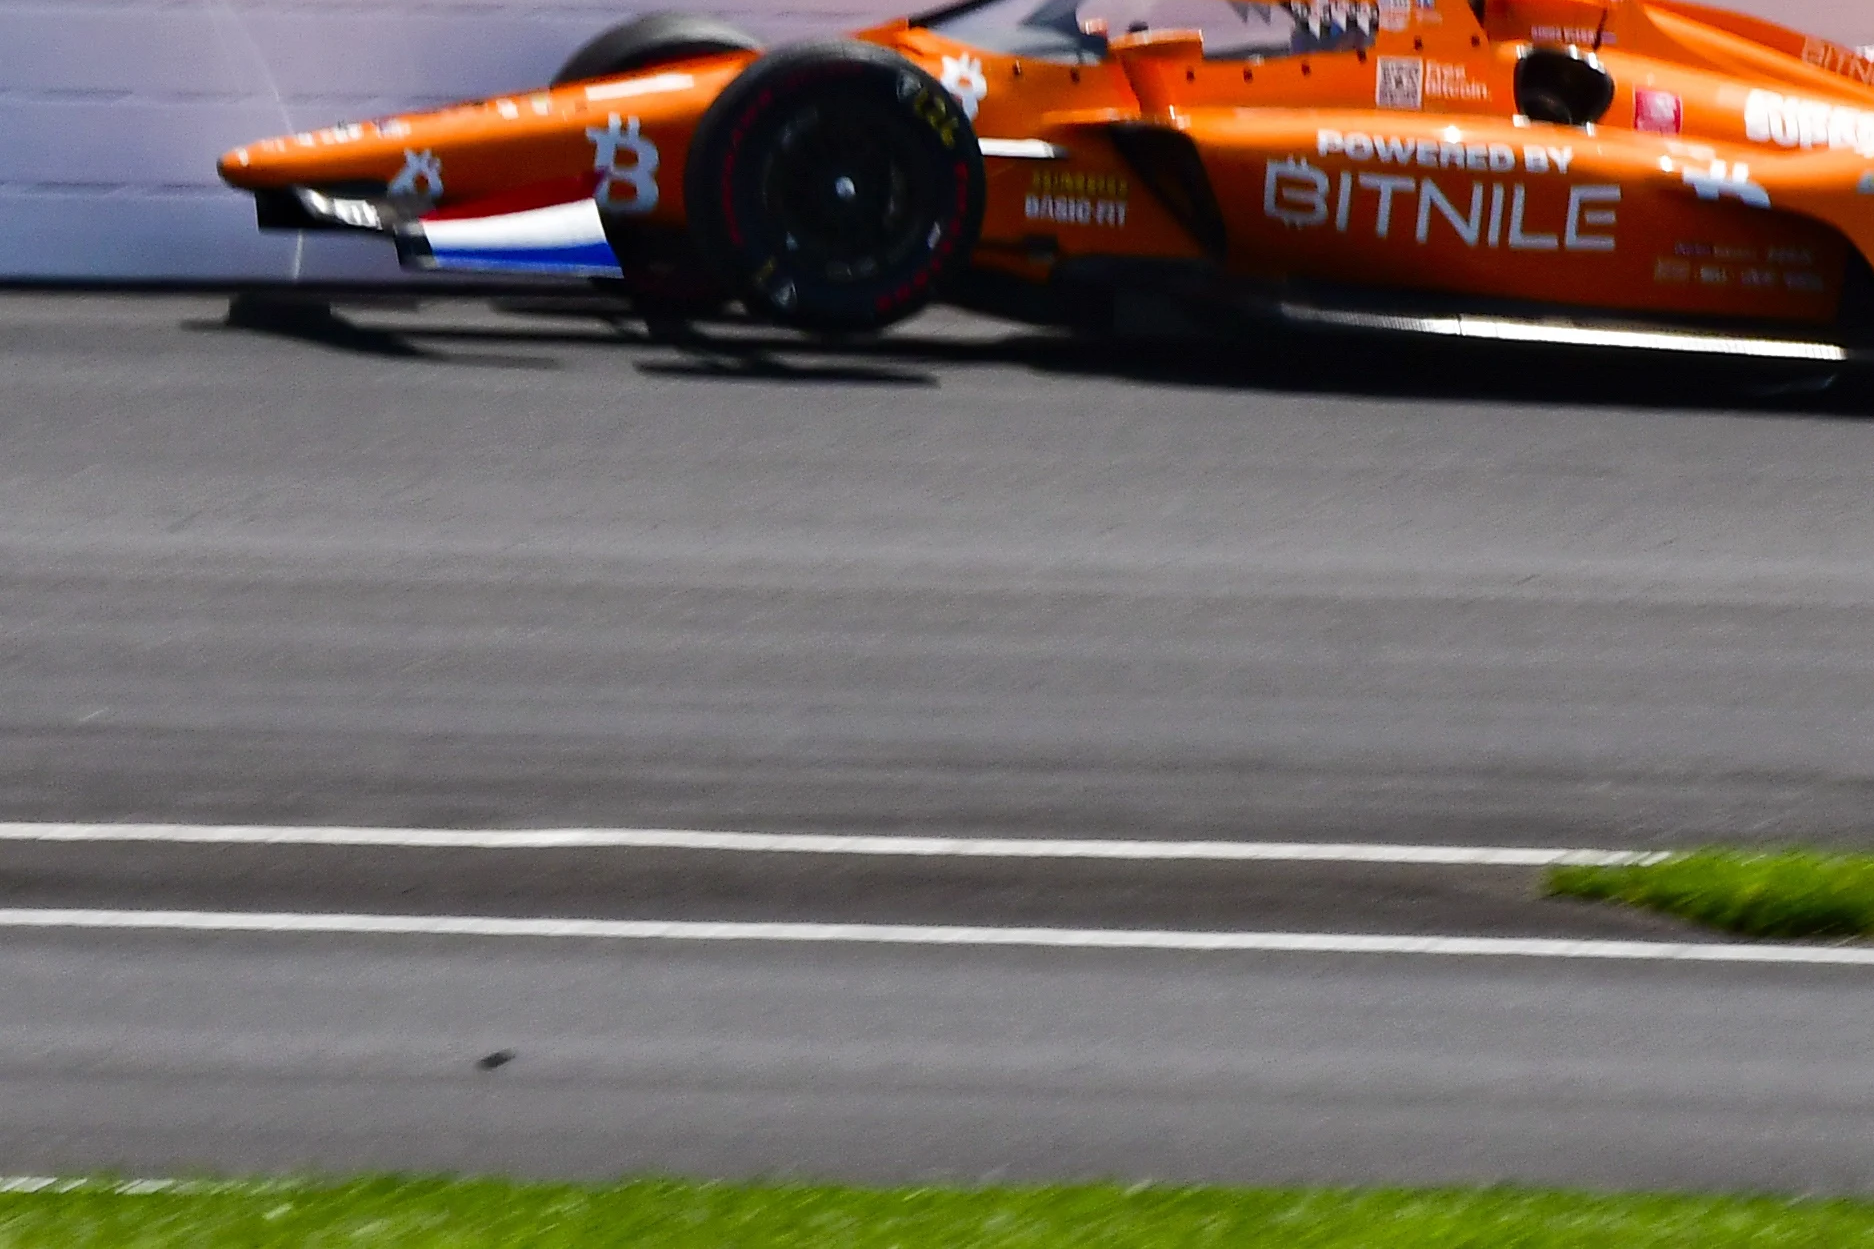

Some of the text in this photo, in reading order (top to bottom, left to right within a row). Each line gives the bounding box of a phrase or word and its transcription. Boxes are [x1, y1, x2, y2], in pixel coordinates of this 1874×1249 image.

[1316, 129, 1573, 175] POWERED BY
[1264, 153, 1621, 250] BITNILE
